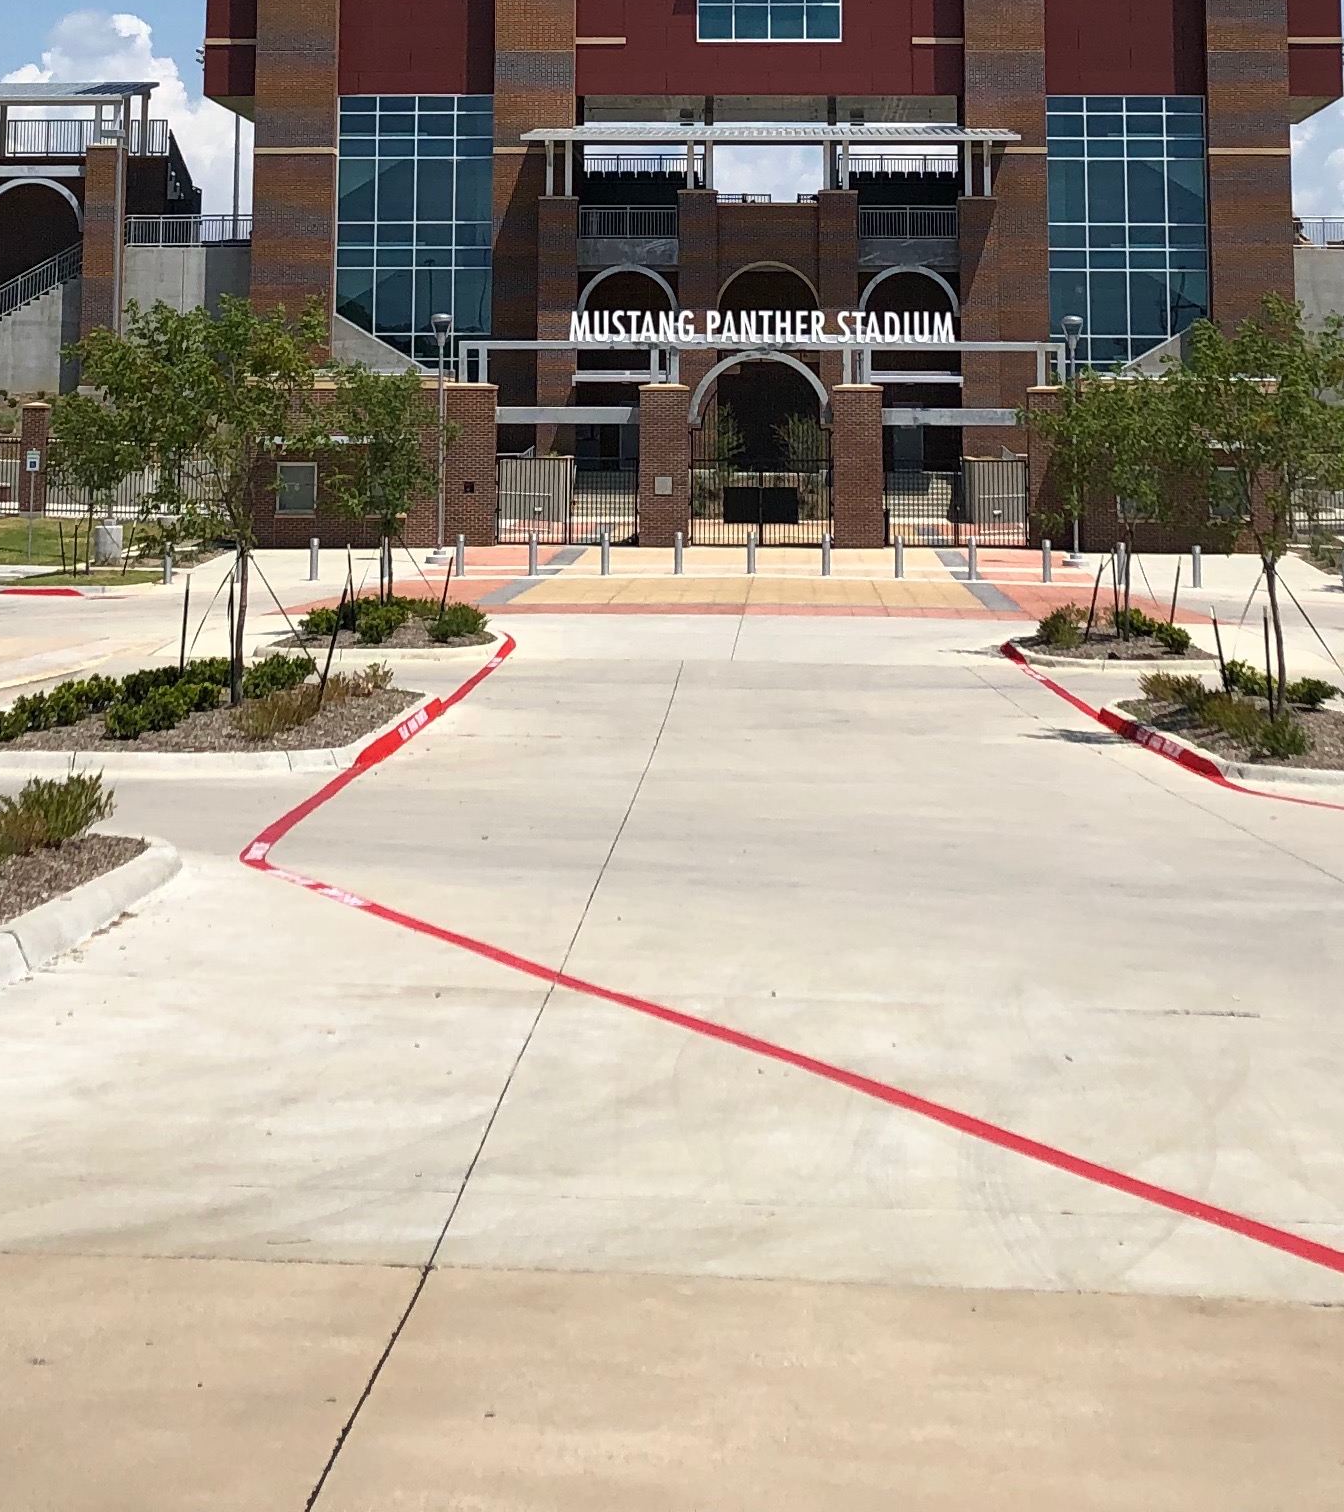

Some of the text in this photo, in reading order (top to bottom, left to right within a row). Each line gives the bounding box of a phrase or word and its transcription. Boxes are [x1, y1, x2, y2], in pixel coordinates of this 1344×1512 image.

[569, 309, 956, 344] MUSTANG PANTHER STADIUM
